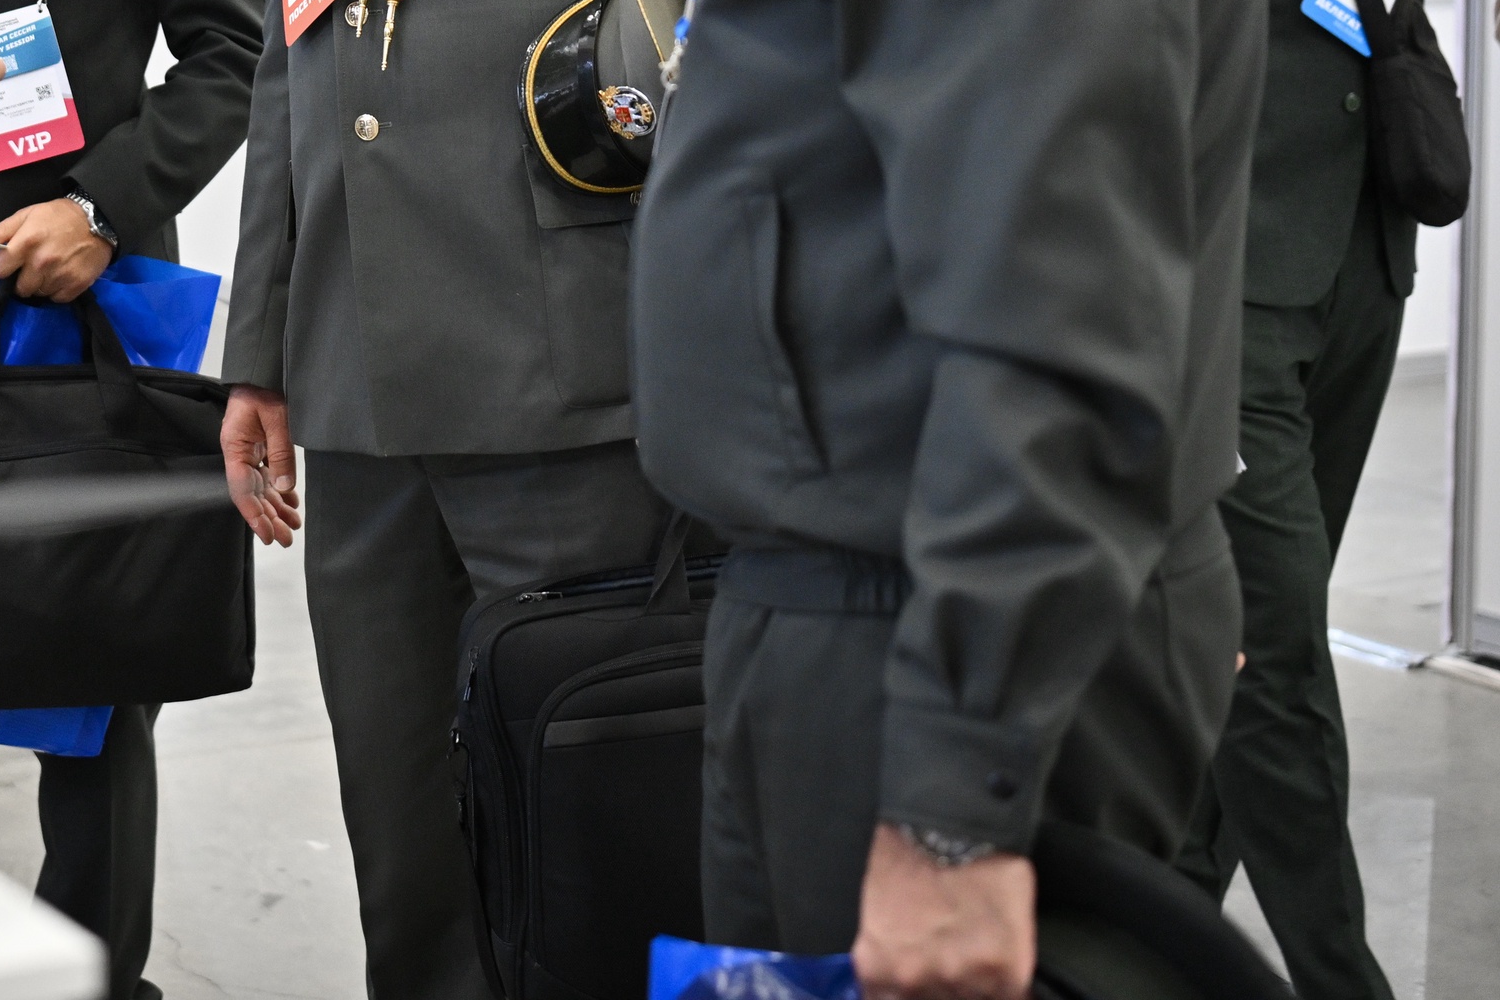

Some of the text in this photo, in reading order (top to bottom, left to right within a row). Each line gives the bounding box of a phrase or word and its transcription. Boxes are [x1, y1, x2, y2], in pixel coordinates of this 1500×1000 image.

[9, 24, 36, 39] СЕССИЯ
[5, 34, 36, 51] SESSION
[8, 130, 52, 157] VIP
